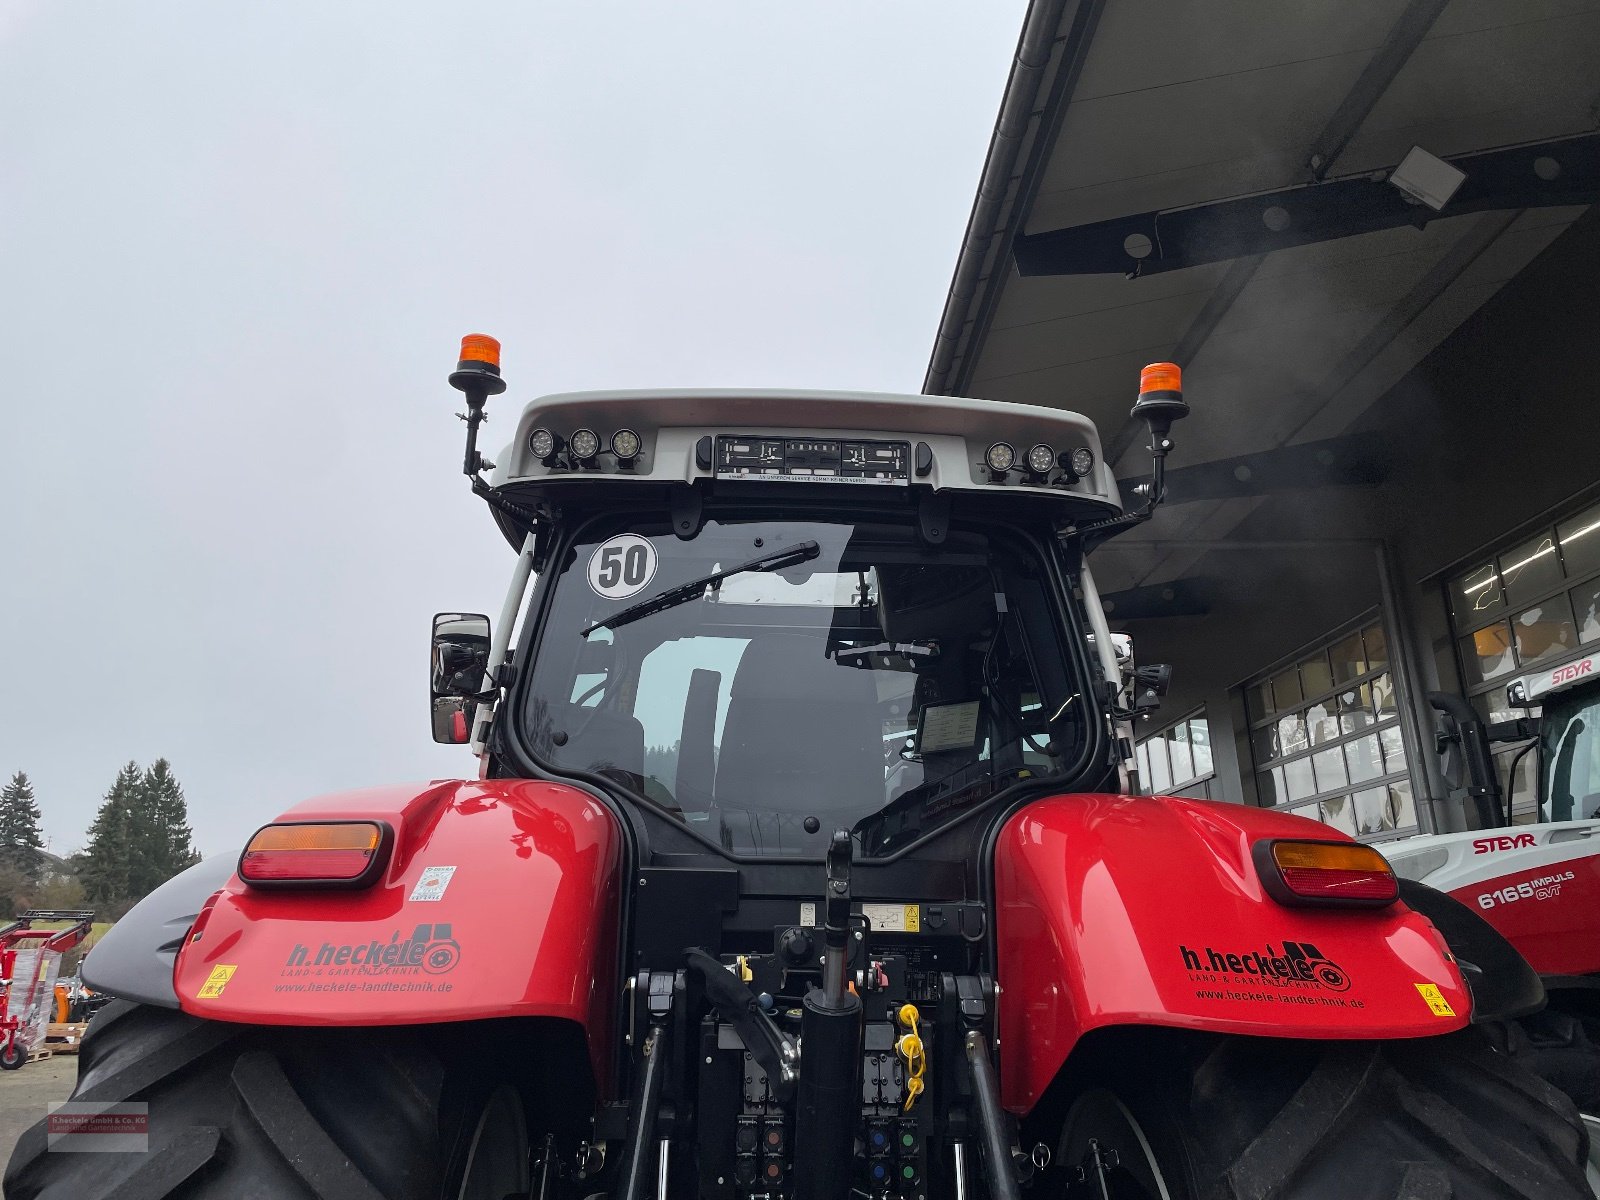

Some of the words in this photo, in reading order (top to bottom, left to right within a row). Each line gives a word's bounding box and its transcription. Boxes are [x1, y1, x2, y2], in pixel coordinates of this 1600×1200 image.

[598, 544, 648, 589] 50
[1551, 658, 1593, 686] STEYR
[1472, 833, 1538, 855] STEYR
[1477, 882, 1535, 910] 6165
[1530, 871, 1575, 889] IMPULS
[1535, 884, 1561, 901] CVT
[274, 981, 453, 993] www.heckele-landtechnik.de
